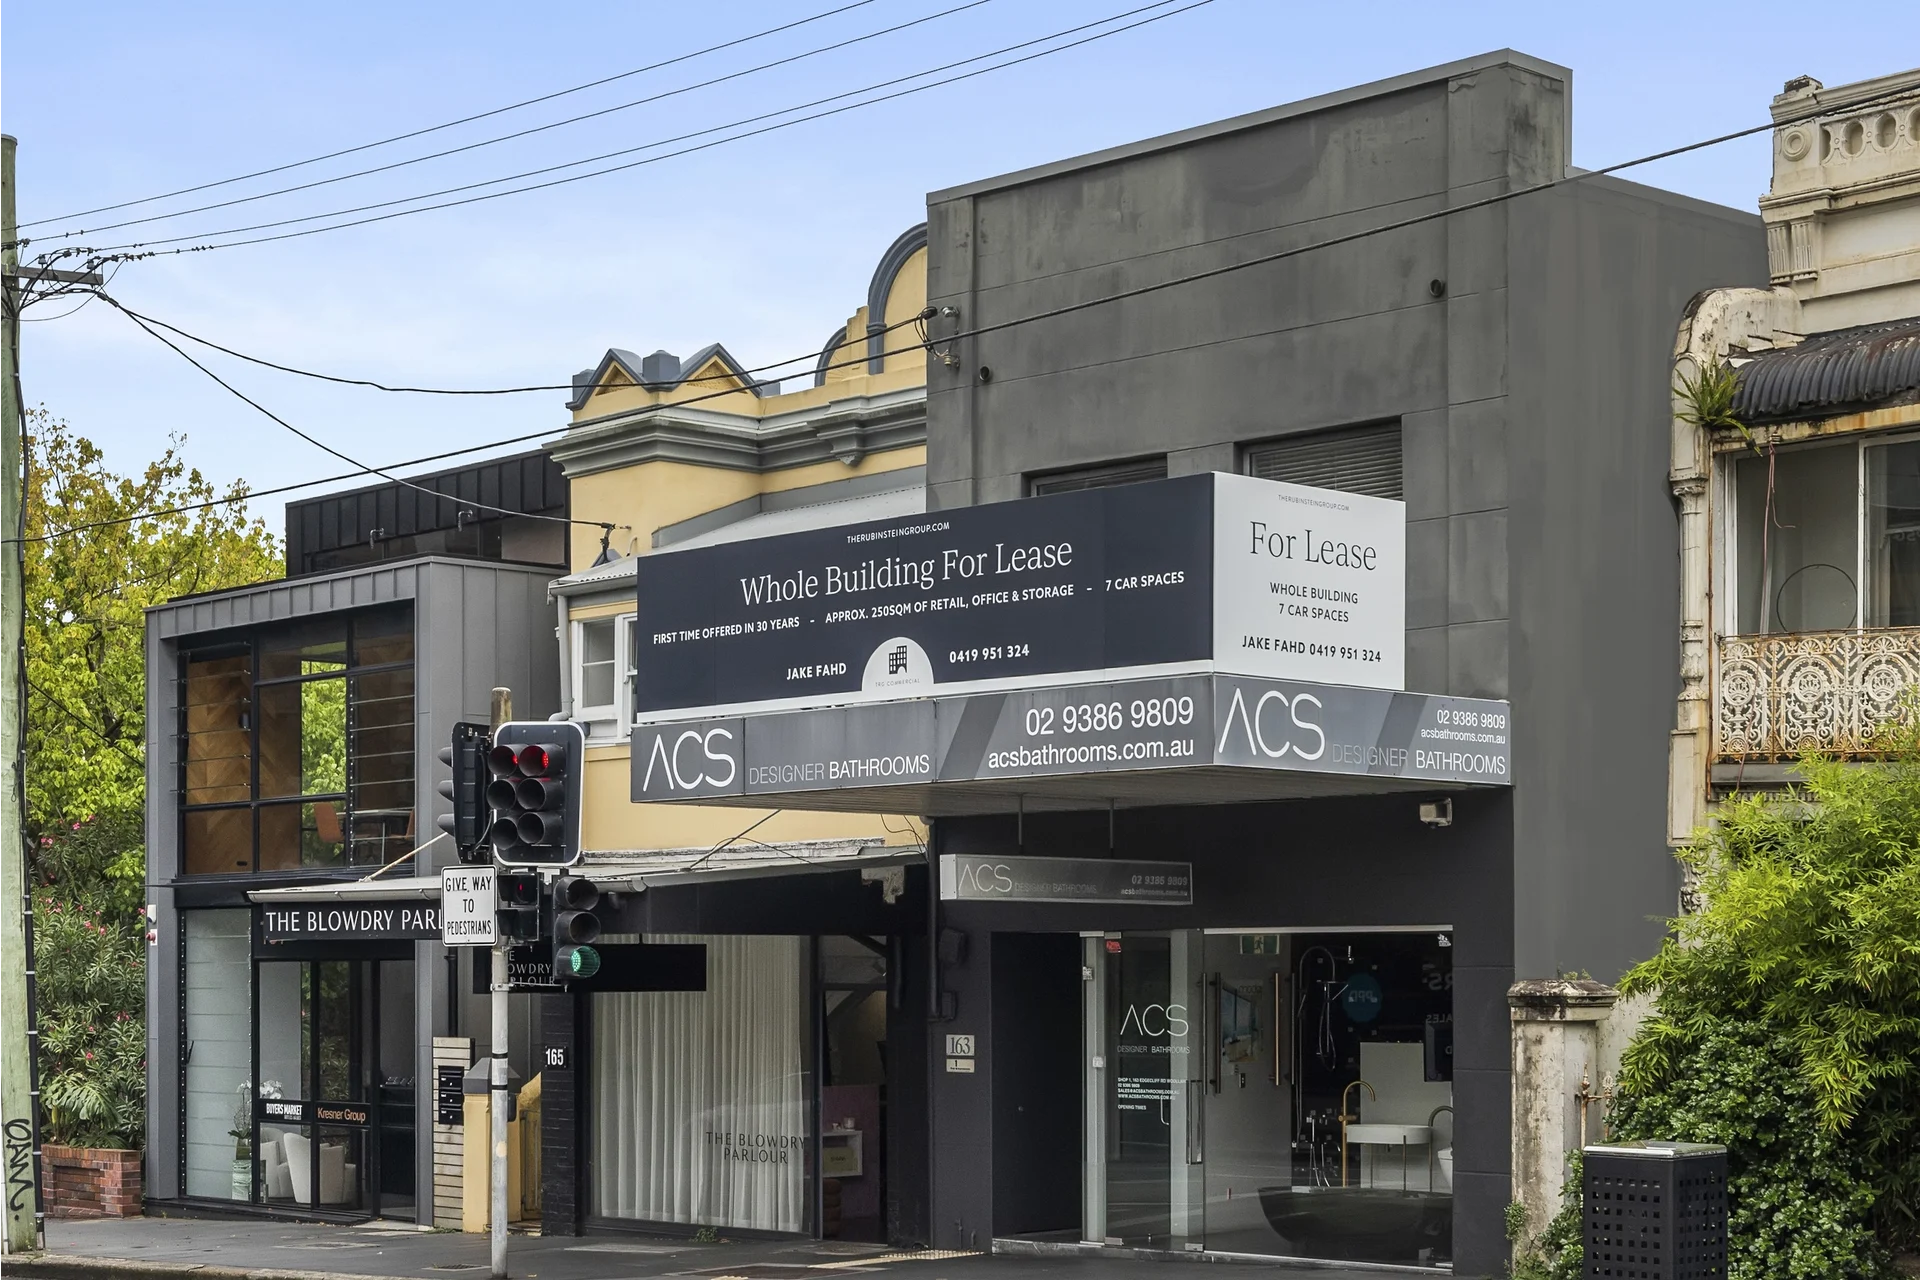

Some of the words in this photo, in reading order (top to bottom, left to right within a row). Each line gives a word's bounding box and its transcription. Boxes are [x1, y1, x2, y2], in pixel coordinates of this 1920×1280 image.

[1278, 494, 1350, 511] THERUBINSTEINGROUP.COM
[847, 521, 950, 544] THERUBINSTEINGROUP.COM
[1249, 520, 1297, 560] For
[1304, 528, 1377, 571] Lease
[740, 569, 819, 606] Whole
[825, 556, 935, 596] Building
[942, 549, 988, 580] For
[995, 541, 1073, 574] Lease
[1270, 581, 1308, 598] WHOLE
[1310, 586, 1359, 605] BUILDING
[653, 631, 677, 644] FIRST
[679, 629, 700, 641] TIME
[702, 624, 743, 638] OFFERED
[744, 622, 754, 633] IN
[756, 621, 768, 632] 30
[770, 616, 800, 631] YEARS
[825, 608, 869, 623] APPROX.
[871, 602, 911, 618] 250SQM
[914, 600, 928, 613] OF
[930, 597, 969, 611] RETAIL,
[972, 592, 1009, 606] OFFICE
[1012, 590, 1020, 602] &
[1022, 584, 1074, 600] STORAGE
[1105, 579, 1112, 592] 7
[1114, 576, 1138, 590] CAR
[1140, 571, 1185, 587] SPACES
[1278, 603, 1285, 615] 7
[1288, 604, 1309, 618] CAR
[1311, 607, 1350, 623] SPACES
[949, 648, 979, 663] 0419
[982, 646, 1003, 661] 951
[1006, 644, 1030, 658] 324
[1242, 635, 1271, 651] JAKE
[1274, 638, 1306, 654] FAHD
[1309, 642, 1336, 658] 0419
[1340, 646, 1359, 661] 951
[1362, 648, 1382, 663] 324
[786, 665, 813, 681] JAKE
[816, 662, 847, 677] FAHD
[1025, 707, 1055, 736] 02
[1062, 701, 1123, 734] 9386
[1130, 696, 1195, 729] 9809
[1218, 687, 1327, 761] ACS
[1436, 709, 1450, 725] 02
[1452, 710, 1478, 727] 9386
[1480, 713, 1506, 730] 9809
[1420, 726, 1506, 745] acsbathrooms.com.au
[642, 727, 736, 792] ACS
[988, 738, 1195, 769] acsbathrooms.com.au
[1332, 743, 1409, 767] DESIGNER
[1415, 749, 1506, 775] BATHROOMS
[749, 762, 825, 785] DESIGNER
[829, 754, 930, 780] BATHROOMS
[446, 877, 468, 892] GIVE
[472, 875, 492, 891] WAY
[958, 864, 1012, 893] ACS
[1052, 882, 1097, 894] BATHROOMS
[1131, 875, 1142, 885] 02
[1167, 876, 1188, 886] 9809
[463, 898, 475, 913] TO
[265, 911, 300, 932] THE
[307, 909, 394, 932] BLOWDRY
[402, 909, 443, 931] PARL
[447, 919, 492, 936] PEDESTRIANS
[507, 963, 552, 974] OWDRY
[510, 976, 555, 987] RLOUR
[1120, 1004, 1189, 1037] ACS
[950, 1036, 971, 1055] 163
[1117, 1045, 1148, 1053] DESIGNER
[1151, 1045, 1191, 1054] BATHROOMS
[545, 1048, 564, 1066] 165
[266, 1103, 283, 1114] BUYERS
[283, 1104, 303, 1115] MARKET
[317, 1107, 344, 1119] Kresner
[344, 1108, 366, 1124] Group
[706, 1131, 732, 1146] THE
[738, 1133, 806, 1150] BLOWDRY
[723, 1148, 789, 1165] PARLOUR
